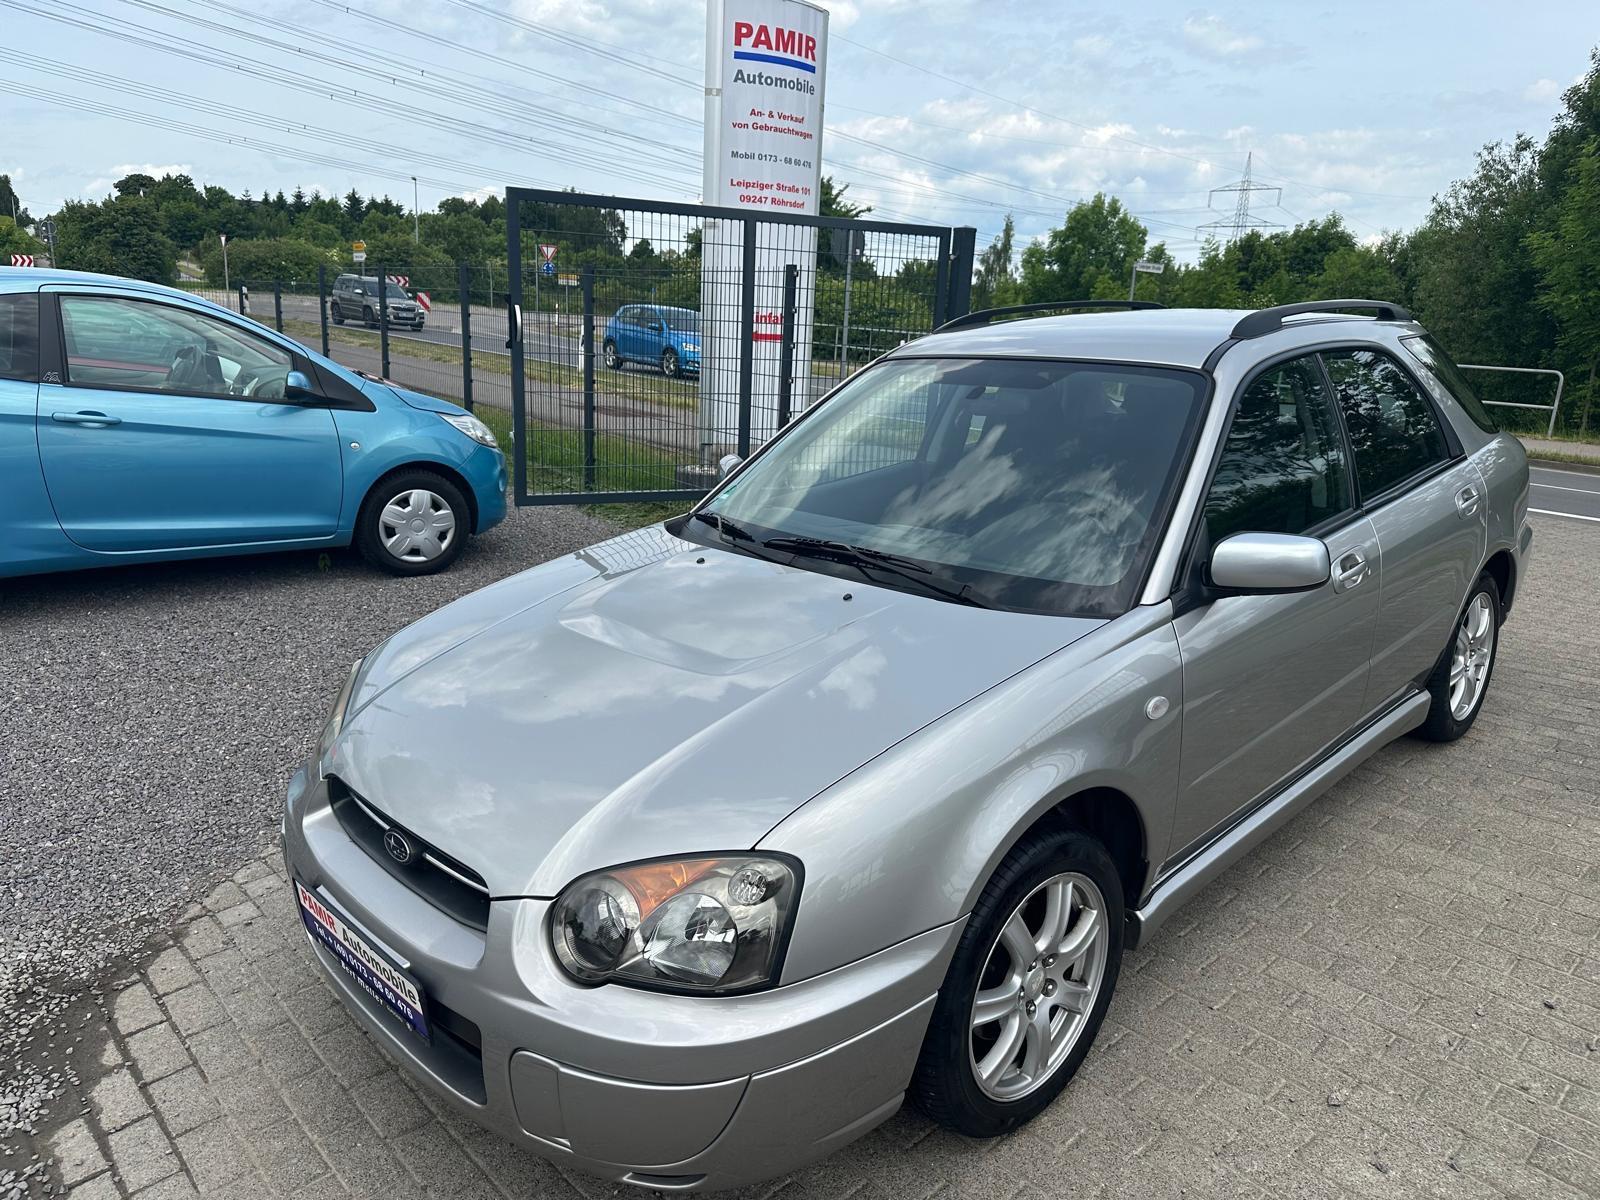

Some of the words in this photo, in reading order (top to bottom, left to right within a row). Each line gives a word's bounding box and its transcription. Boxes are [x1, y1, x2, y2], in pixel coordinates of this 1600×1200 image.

[734, 22, 817, 62] PAMIR
[733, 69, 815, 95] Automobile
[749, 108, 766, 118] An-
[777, 111, 805, 124] Verkauf
[732, 121, 749, 130] von
[751, 122, 813, 140] Gebrauchtwagen
[731, 150, 756, 161] Mobil
[757, 153, 778, 163] 0173
[784, 157, 793, 166] 68
[793, 158, 801, 167] 60
[802, 159, 812, 169] 476
[730, 178, 775, 193] Leipziger
[775, 183, 800, 194] Straße
[801, 186, 811, 196] 101
[739, 194, 768, 205] 09247
[770, 197, 805, 209] Röhrsdorf
[300, 888, 337, 933] PAMIR
[342, 927, 417, 1005] Automobile
[314, 921, 328, 940] Tel.
[349, 954, 368, 977] 0173
[397, 998, 414, 1020] 476
